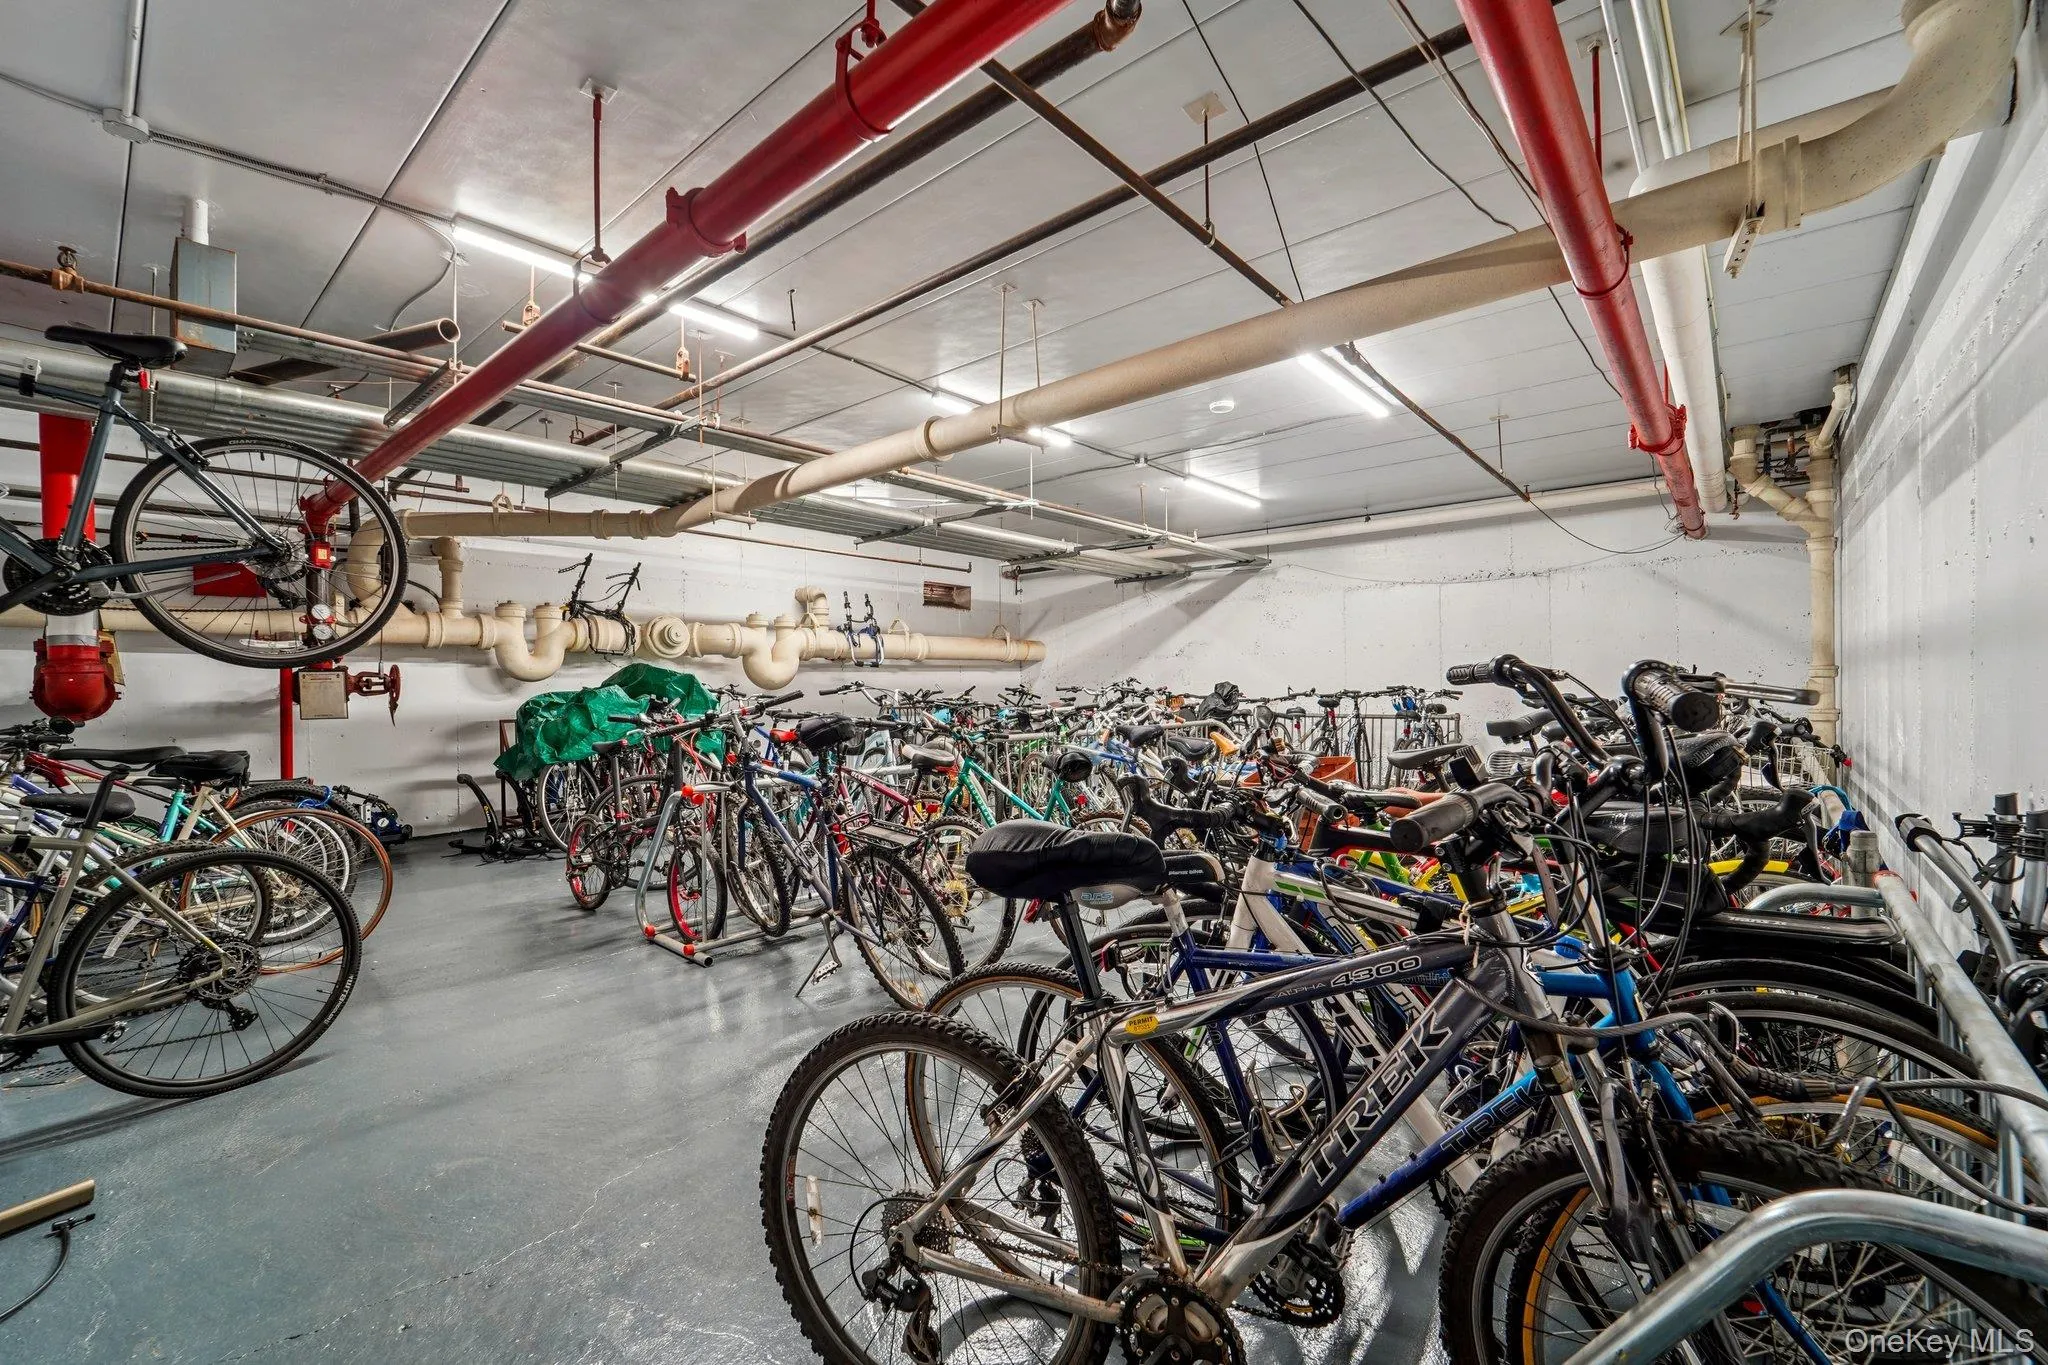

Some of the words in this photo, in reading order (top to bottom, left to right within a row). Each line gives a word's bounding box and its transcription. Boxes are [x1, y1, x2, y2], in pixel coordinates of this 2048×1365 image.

[969, 784, 996, 826] ROADMAST
[1277, 982, 1328, 998] ALPHA
[1331, 955, 1422, 989] 4300
[1128, 1015, 1154, 1027] PERMIT
[1300, 1007, 1453, 1188] TREK
[1440, 1074, 1546, 1155] TREK
